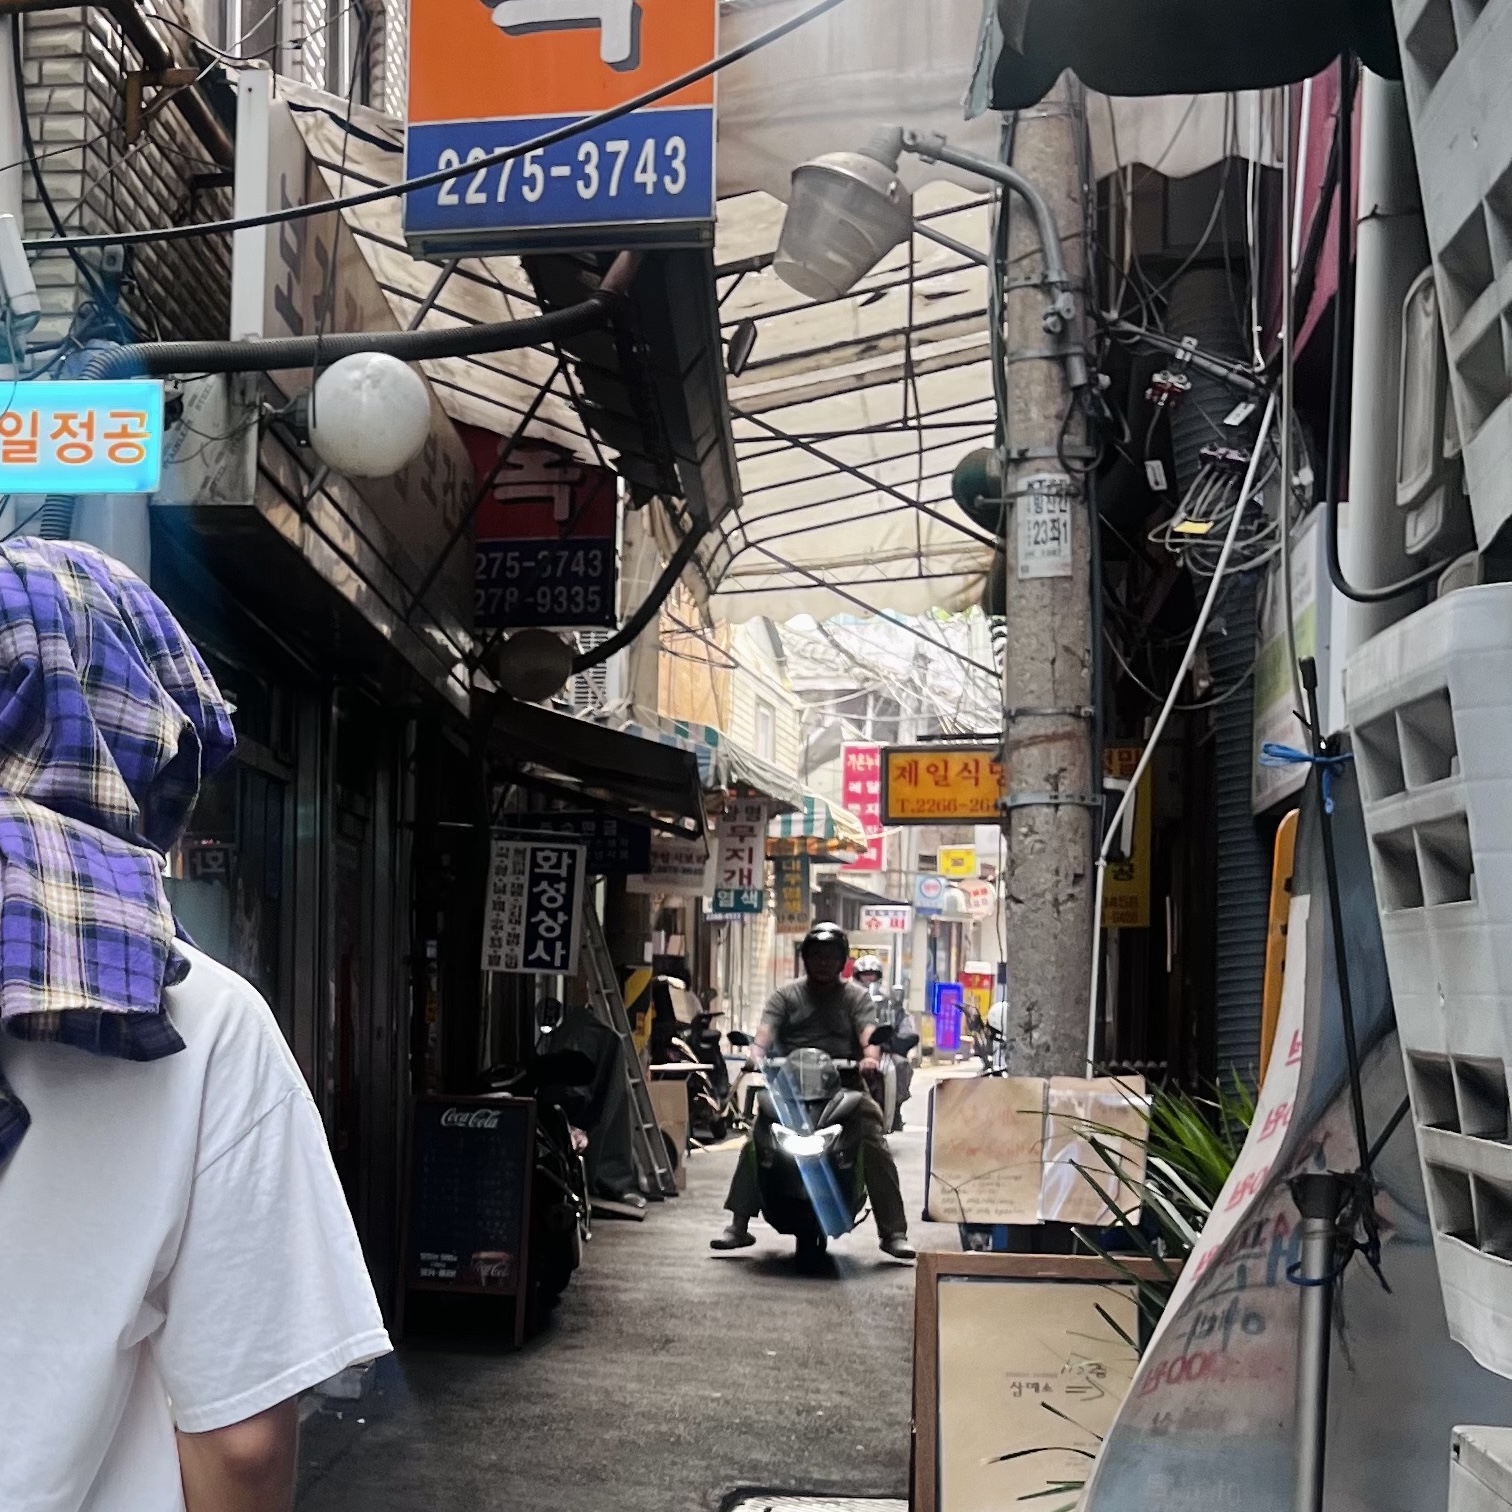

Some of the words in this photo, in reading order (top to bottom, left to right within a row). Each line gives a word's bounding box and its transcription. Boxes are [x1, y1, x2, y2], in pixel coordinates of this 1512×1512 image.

[437, 136, 687, 206] 2275-3743
[475, 550, 603, 580] 275-3743
[897, 798, 999, 814] T.2266-26
[528, 848, 573, 968] 화성상사
